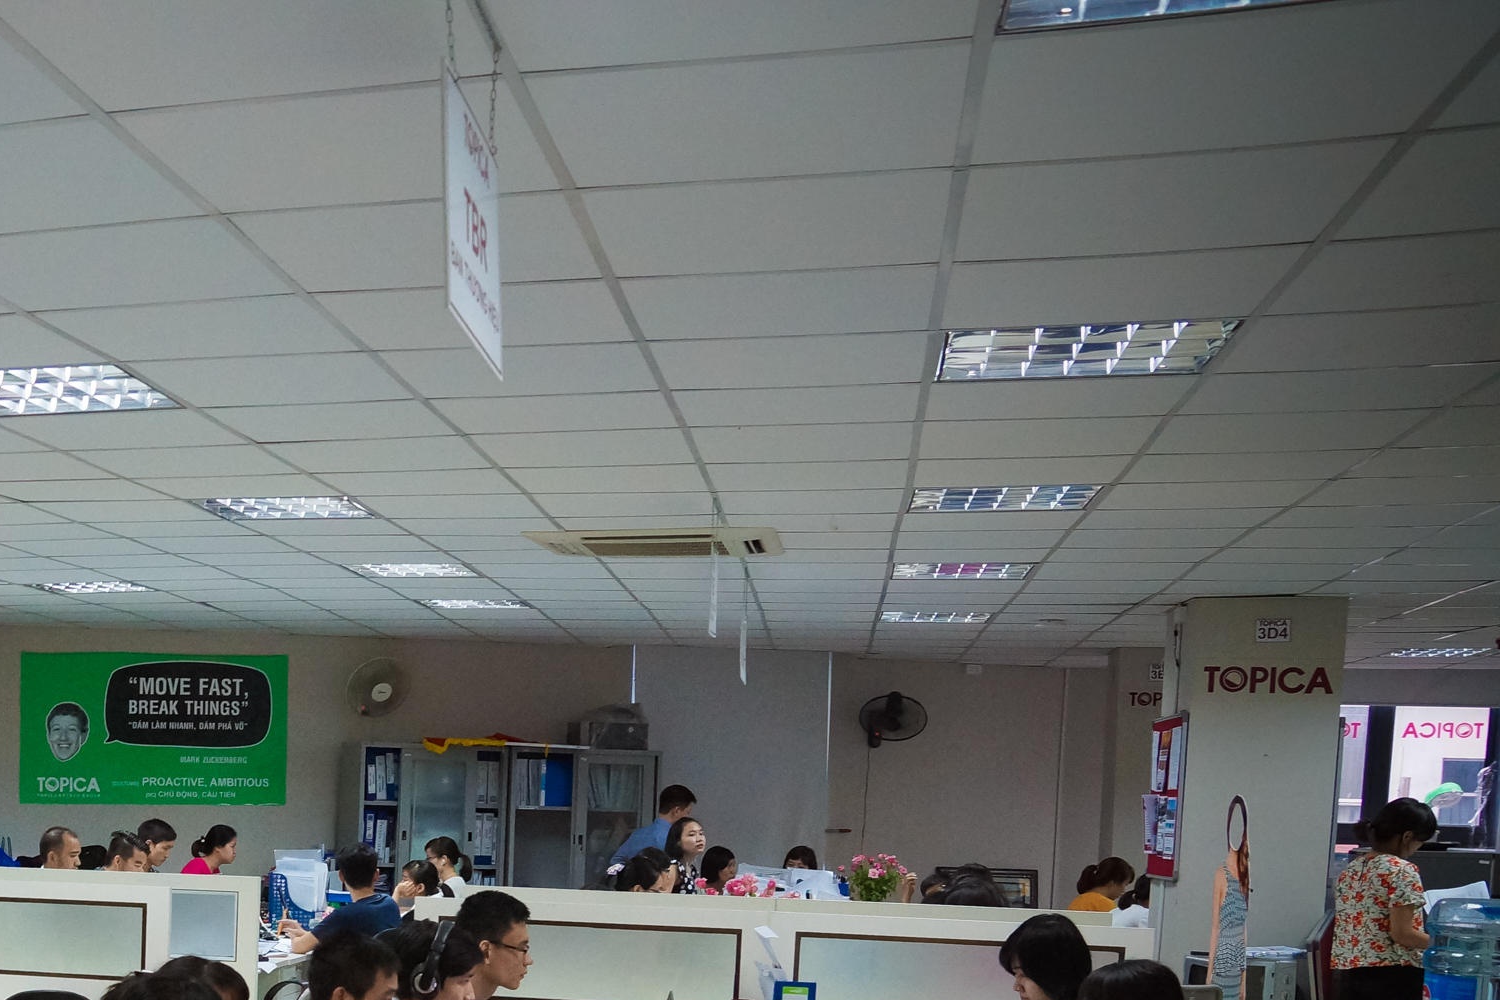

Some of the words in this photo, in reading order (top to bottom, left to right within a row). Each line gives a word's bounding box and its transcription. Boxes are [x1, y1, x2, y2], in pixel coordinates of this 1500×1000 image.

[464, 186, 488, 273] TBR
[1257, 626, 1290, 640] 3D4
[1151, 670, 1164, 680] 3E
[1204, 666, 1334, 694] TOPICA
[199, 678, 248, 699] FAST,
[128, 700, 178, 714] BREAK
[1129, 691, 1162, 707] TOP
[37, 776, 100, 792] TOPICA
[210, 777, 269, 787] AMBITIOUS
